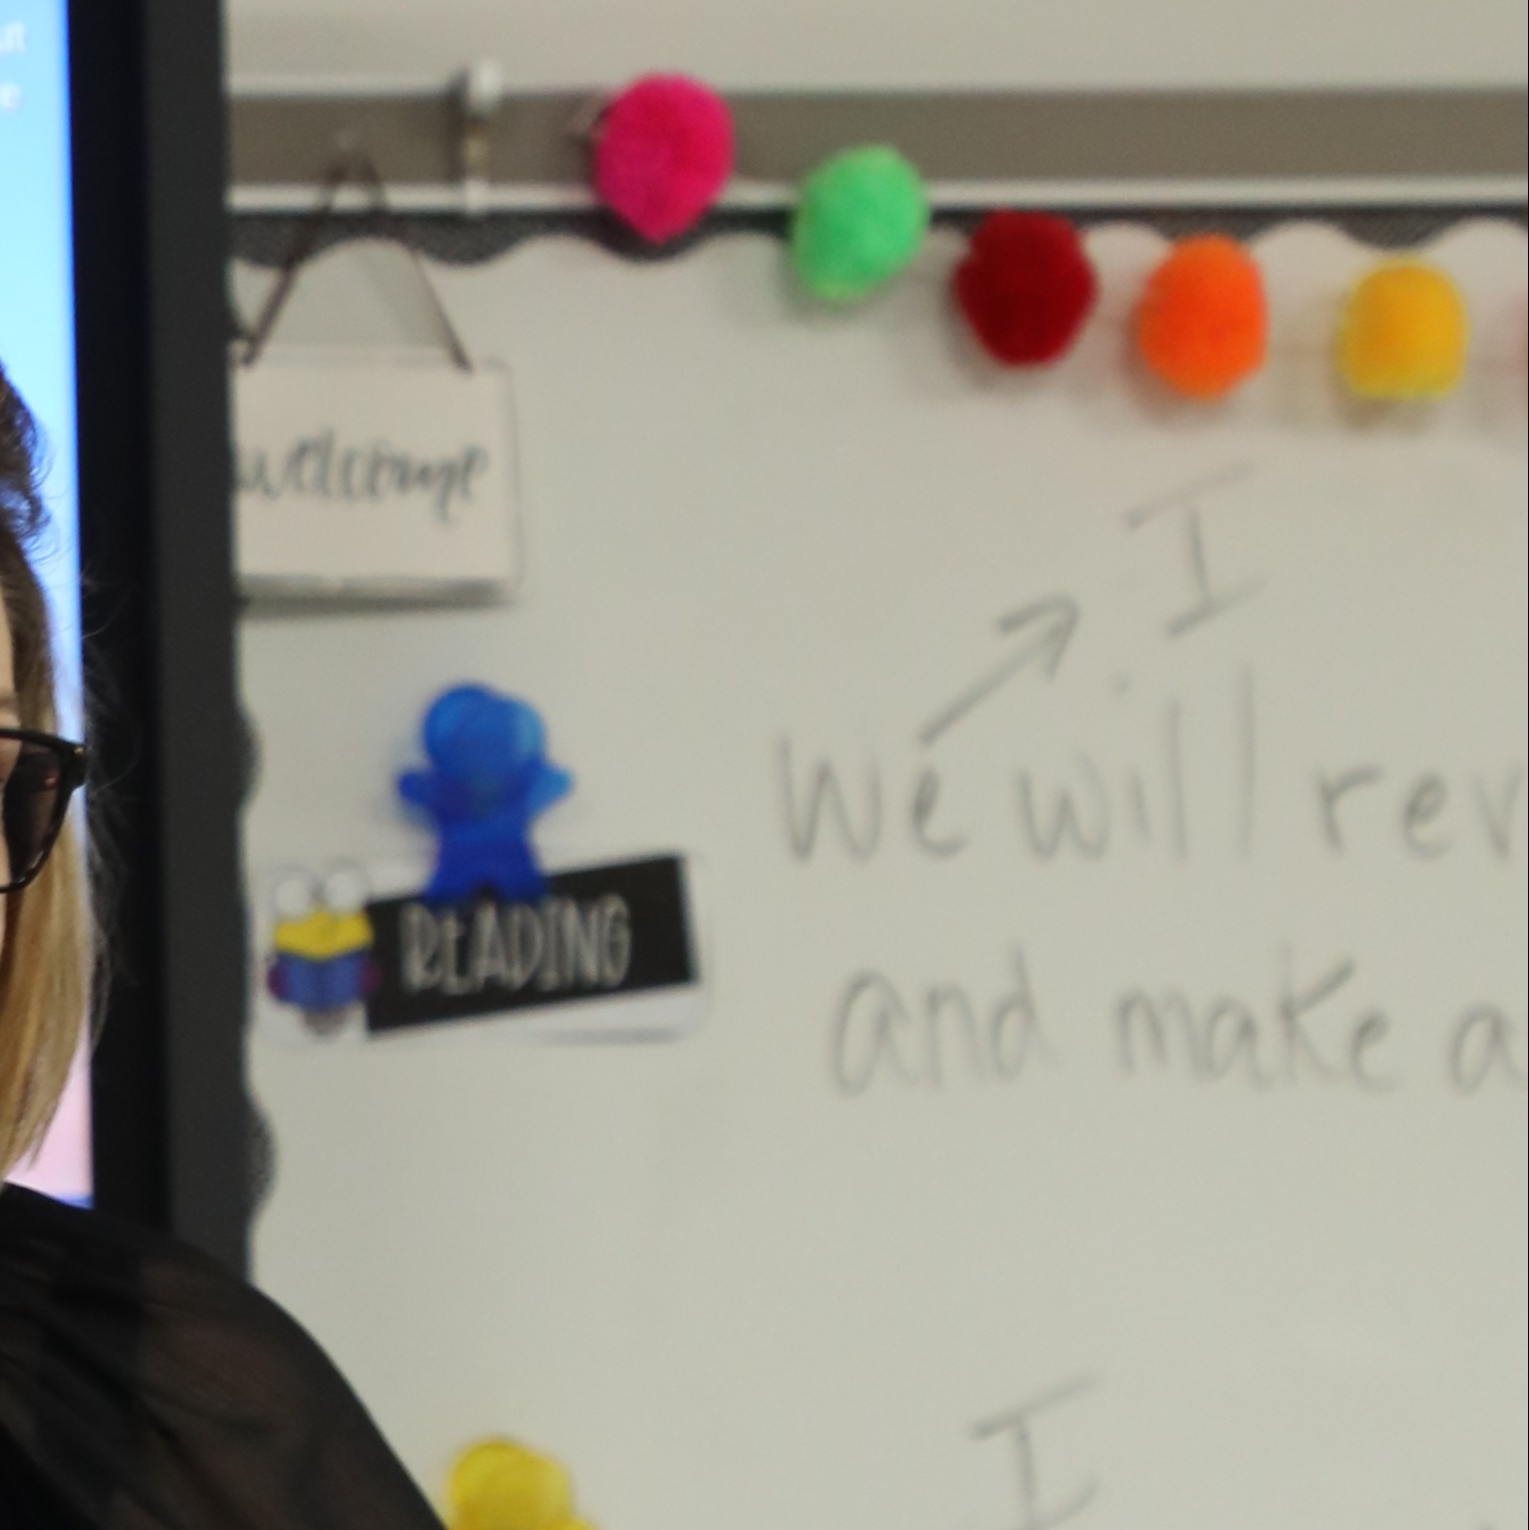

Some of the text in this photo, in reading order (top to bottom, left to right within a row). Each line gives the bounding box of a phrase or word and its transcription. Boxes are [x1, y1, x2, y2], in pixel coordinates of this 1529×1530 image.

[775, 732, 970, 866] We
[1012, 660, 1260, 866] will
[396, 892, 633, 996] READING
[828, 940, 1060, 1098] and
[1112, 938, 1405, 1094] make
